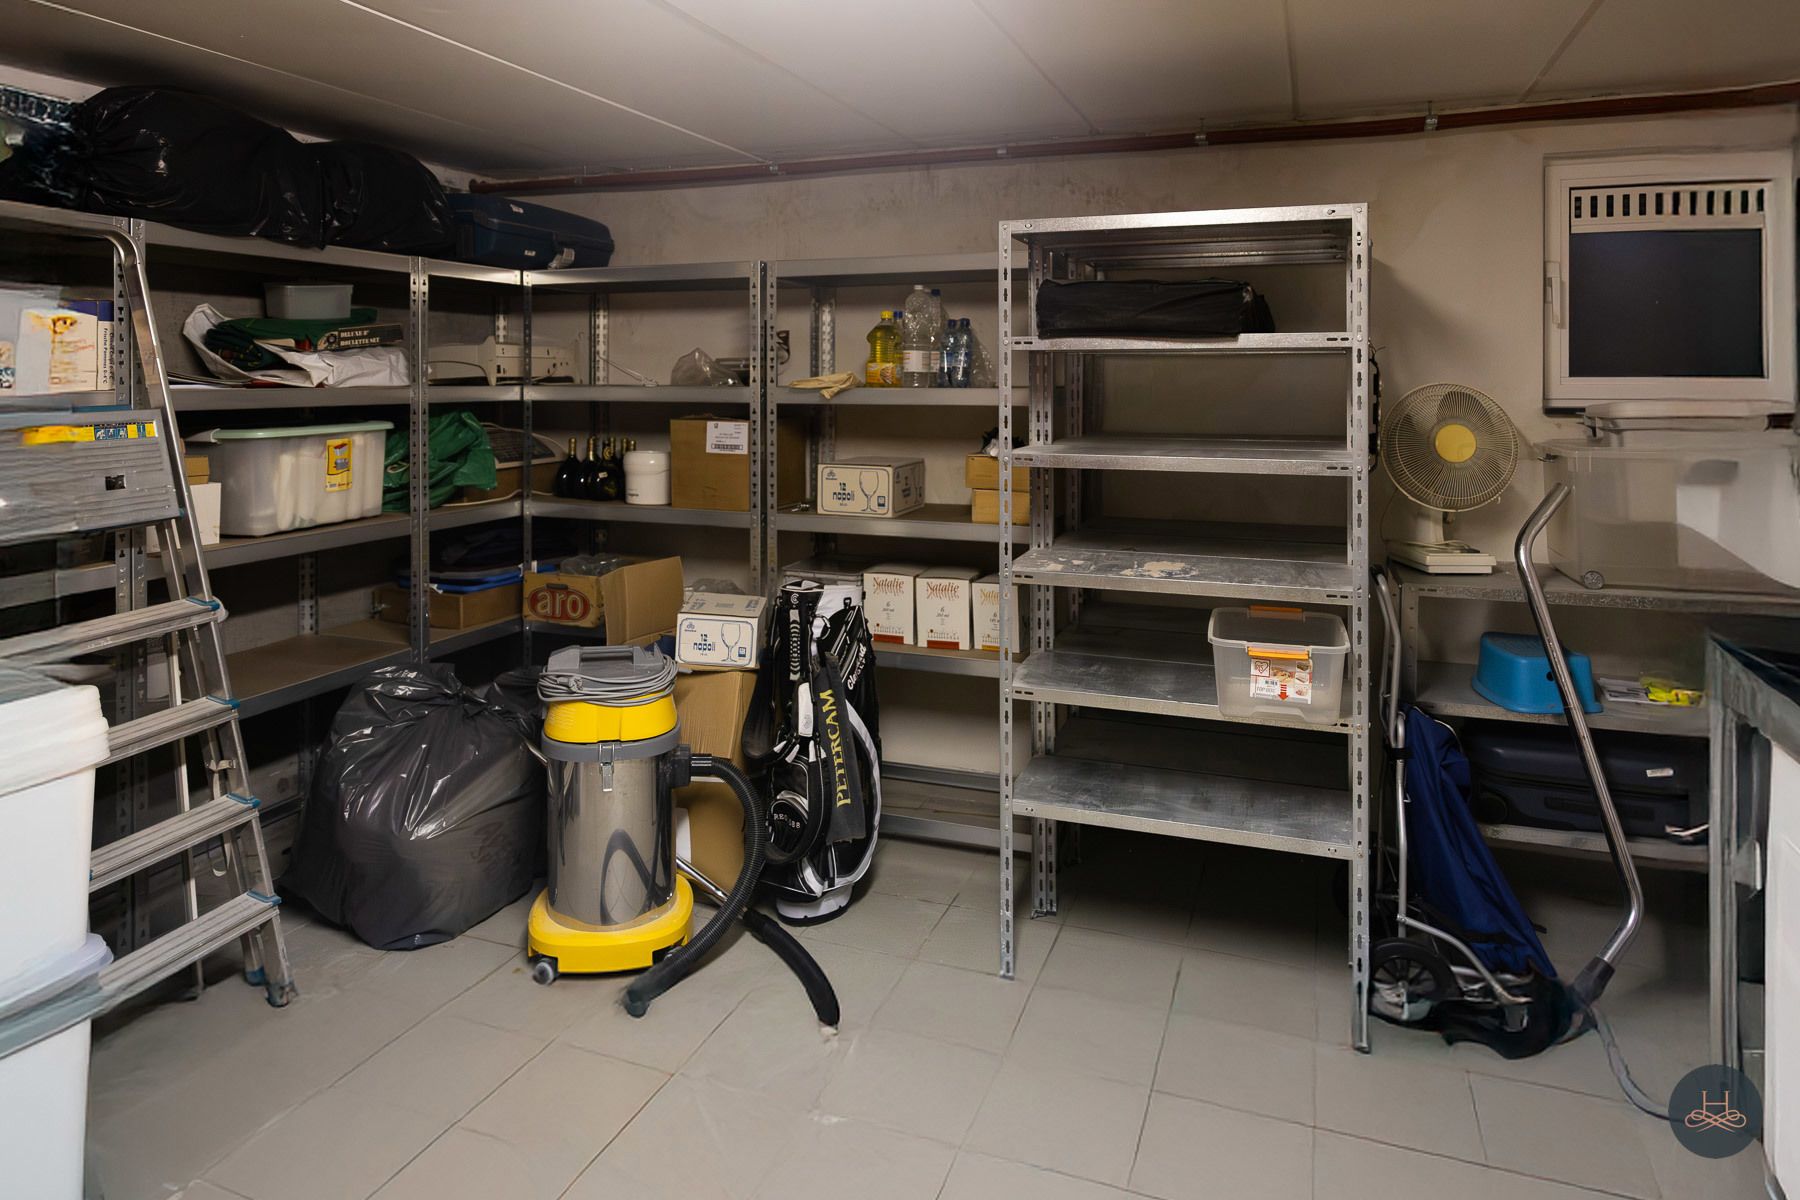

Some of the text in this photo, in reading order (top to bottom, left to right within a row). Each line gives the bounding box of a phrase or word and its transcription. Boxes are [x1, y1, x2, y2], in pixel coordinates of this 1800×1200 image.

[839, 482, 847, 491] 12
[832, 490, 854, 503] napoli
[873, 577, 904, 590] Natalie
[926, 582, 960, 594] Natalie
[537, 591, 584, 619] aro
[700, 633, 708, 642] 12
[693, 641, 716, 653] napoli
[819, 689, 852, 808] PETERCAM
